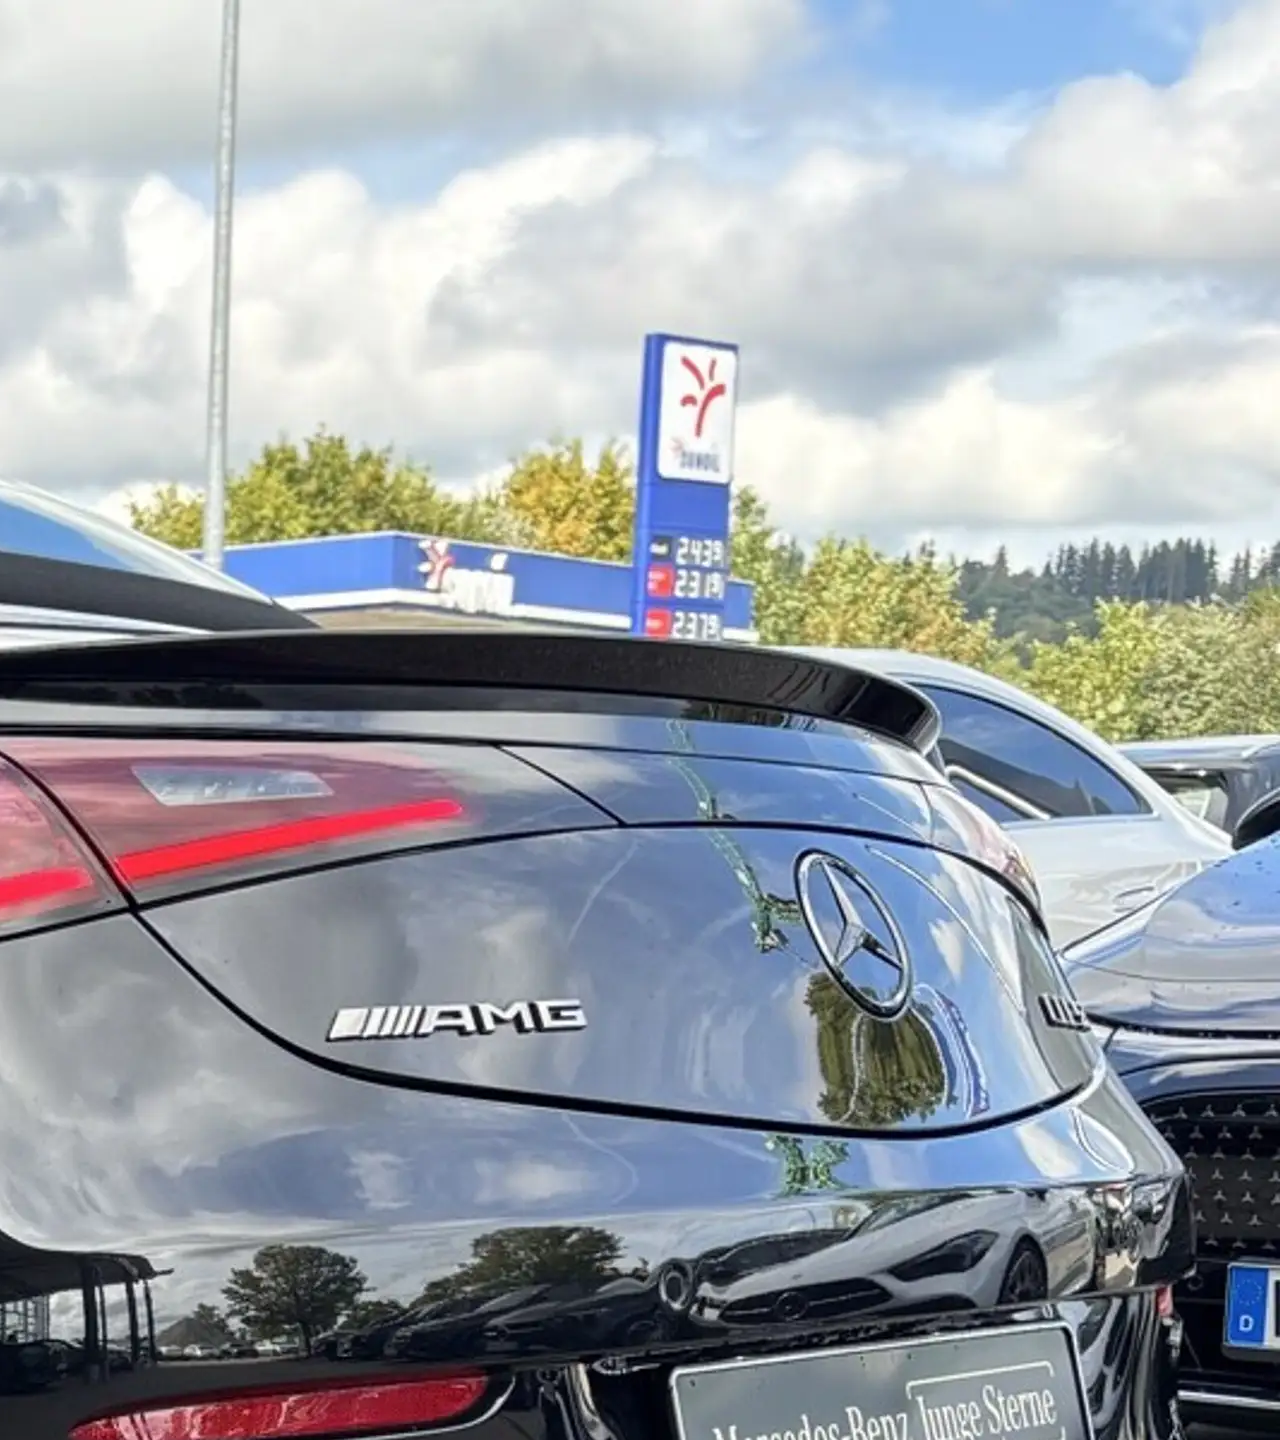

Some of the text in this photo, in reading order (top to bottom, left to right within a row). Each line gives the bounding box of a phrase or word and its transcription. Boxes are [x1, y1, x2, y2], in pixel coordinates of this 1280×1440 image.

[417, 998, 589, 1038] AMG
[1239, 1313, 1255, 1333] D
[981, 1384, 1057, 1436] Sterne
